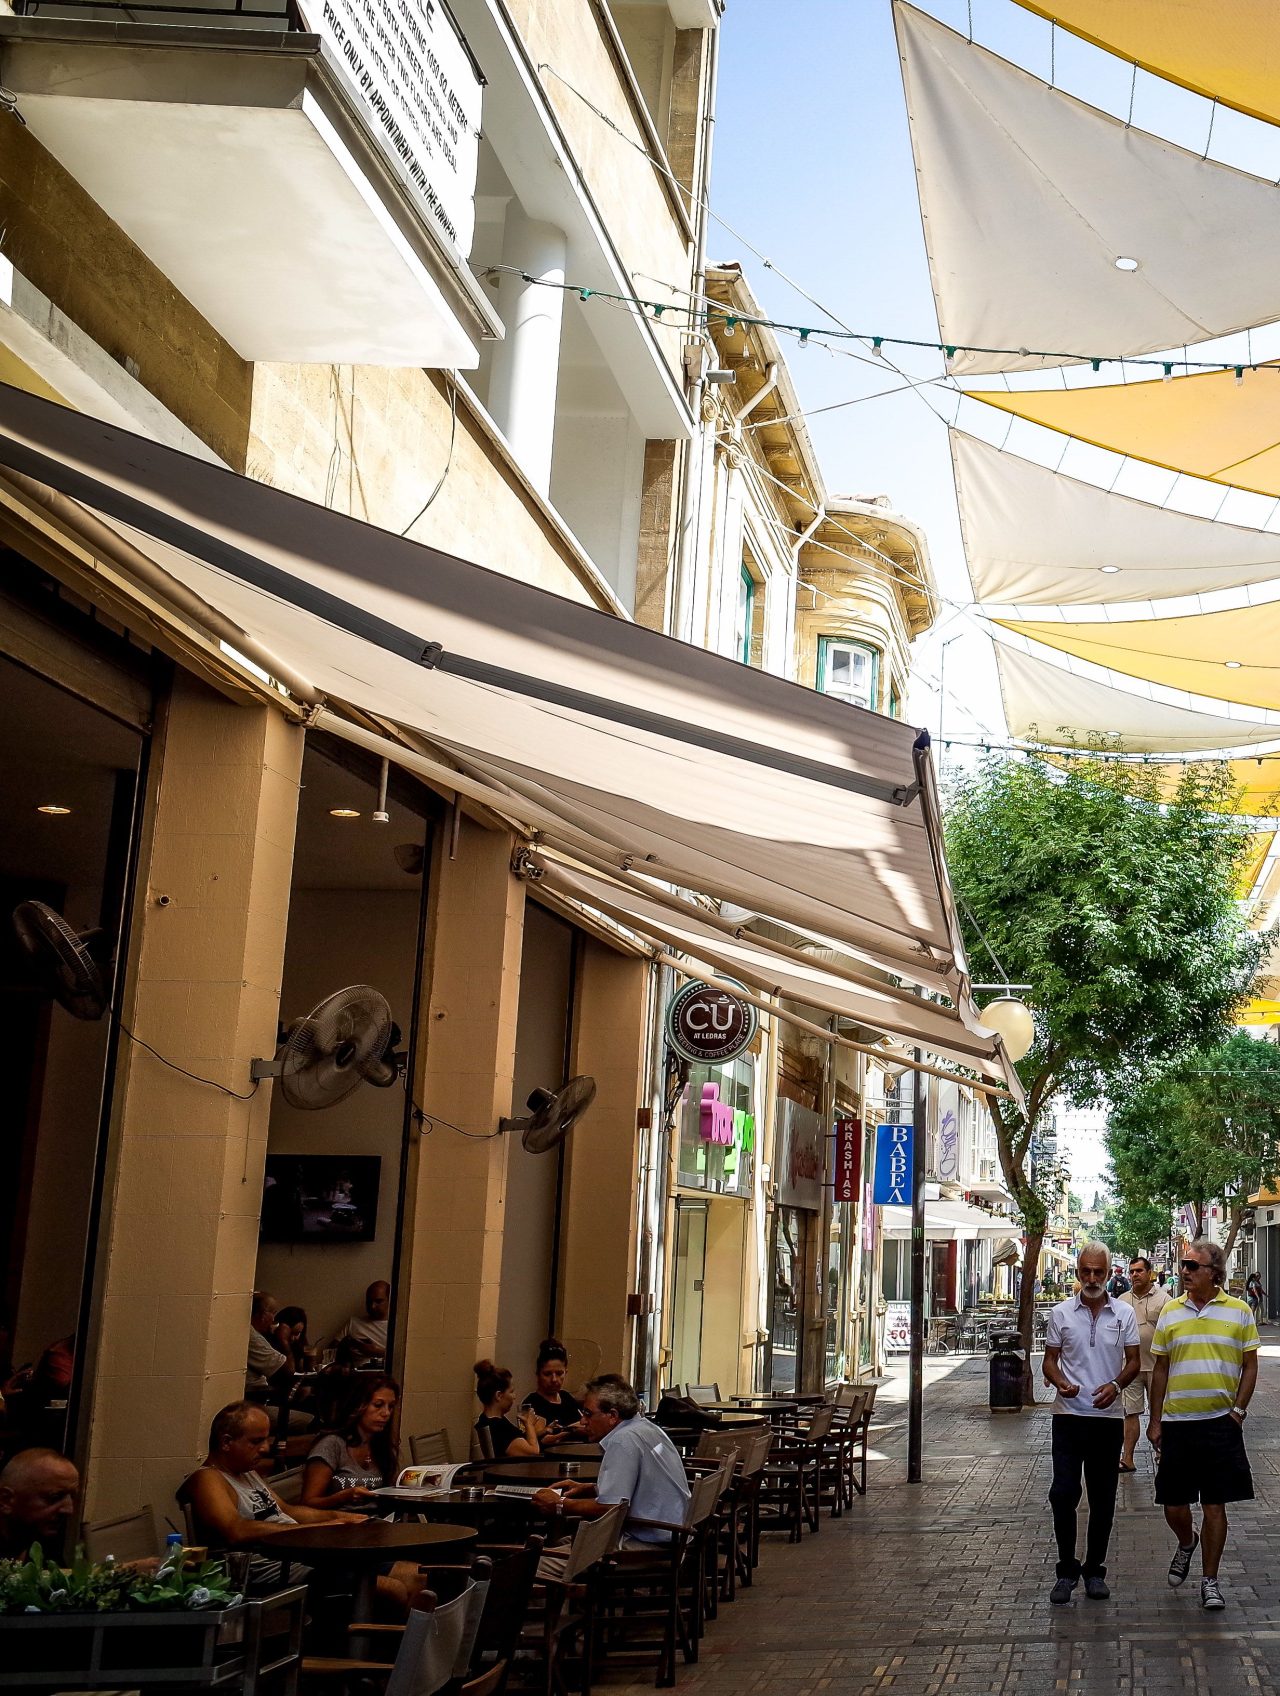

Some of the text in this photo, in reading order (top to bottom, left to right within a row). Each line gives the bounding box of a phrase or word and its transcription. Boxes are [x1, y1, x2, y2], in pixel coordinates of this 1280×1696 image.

[363, 0, 458, 175] THE UPPER TWO FLOORS ARE IDEAL
[370, 41, 390, 87] HOTEL
[382, 0, 399, 40] BOTH
[400, 31, 424, 85] STREETS
[447, 120, 458, 146] AND
[427, 49, 440, 79] 1050
[447, 89, 468, 133] METERS
[323, 0, 346, 46] PRICE
[343, 39, 365, 77] ONLY
[360, 69, 374, 93] BY
[369, 88, 414, 165] APPOINTMENT
[409, 157, 430, 191] WITH
[424, 182, 438, 210] THE
[677, 1033, 697, 1055] MEETING
[704, 1049, 730, 1058] COFFEE
[728, 1033, 746, 1052] PLACE
[686, 1003, 736, 1031] CU
[694, 1032, 727, 1040] AT LEDRAS
[843, 1122, 854, 1198] KRASHIAS
